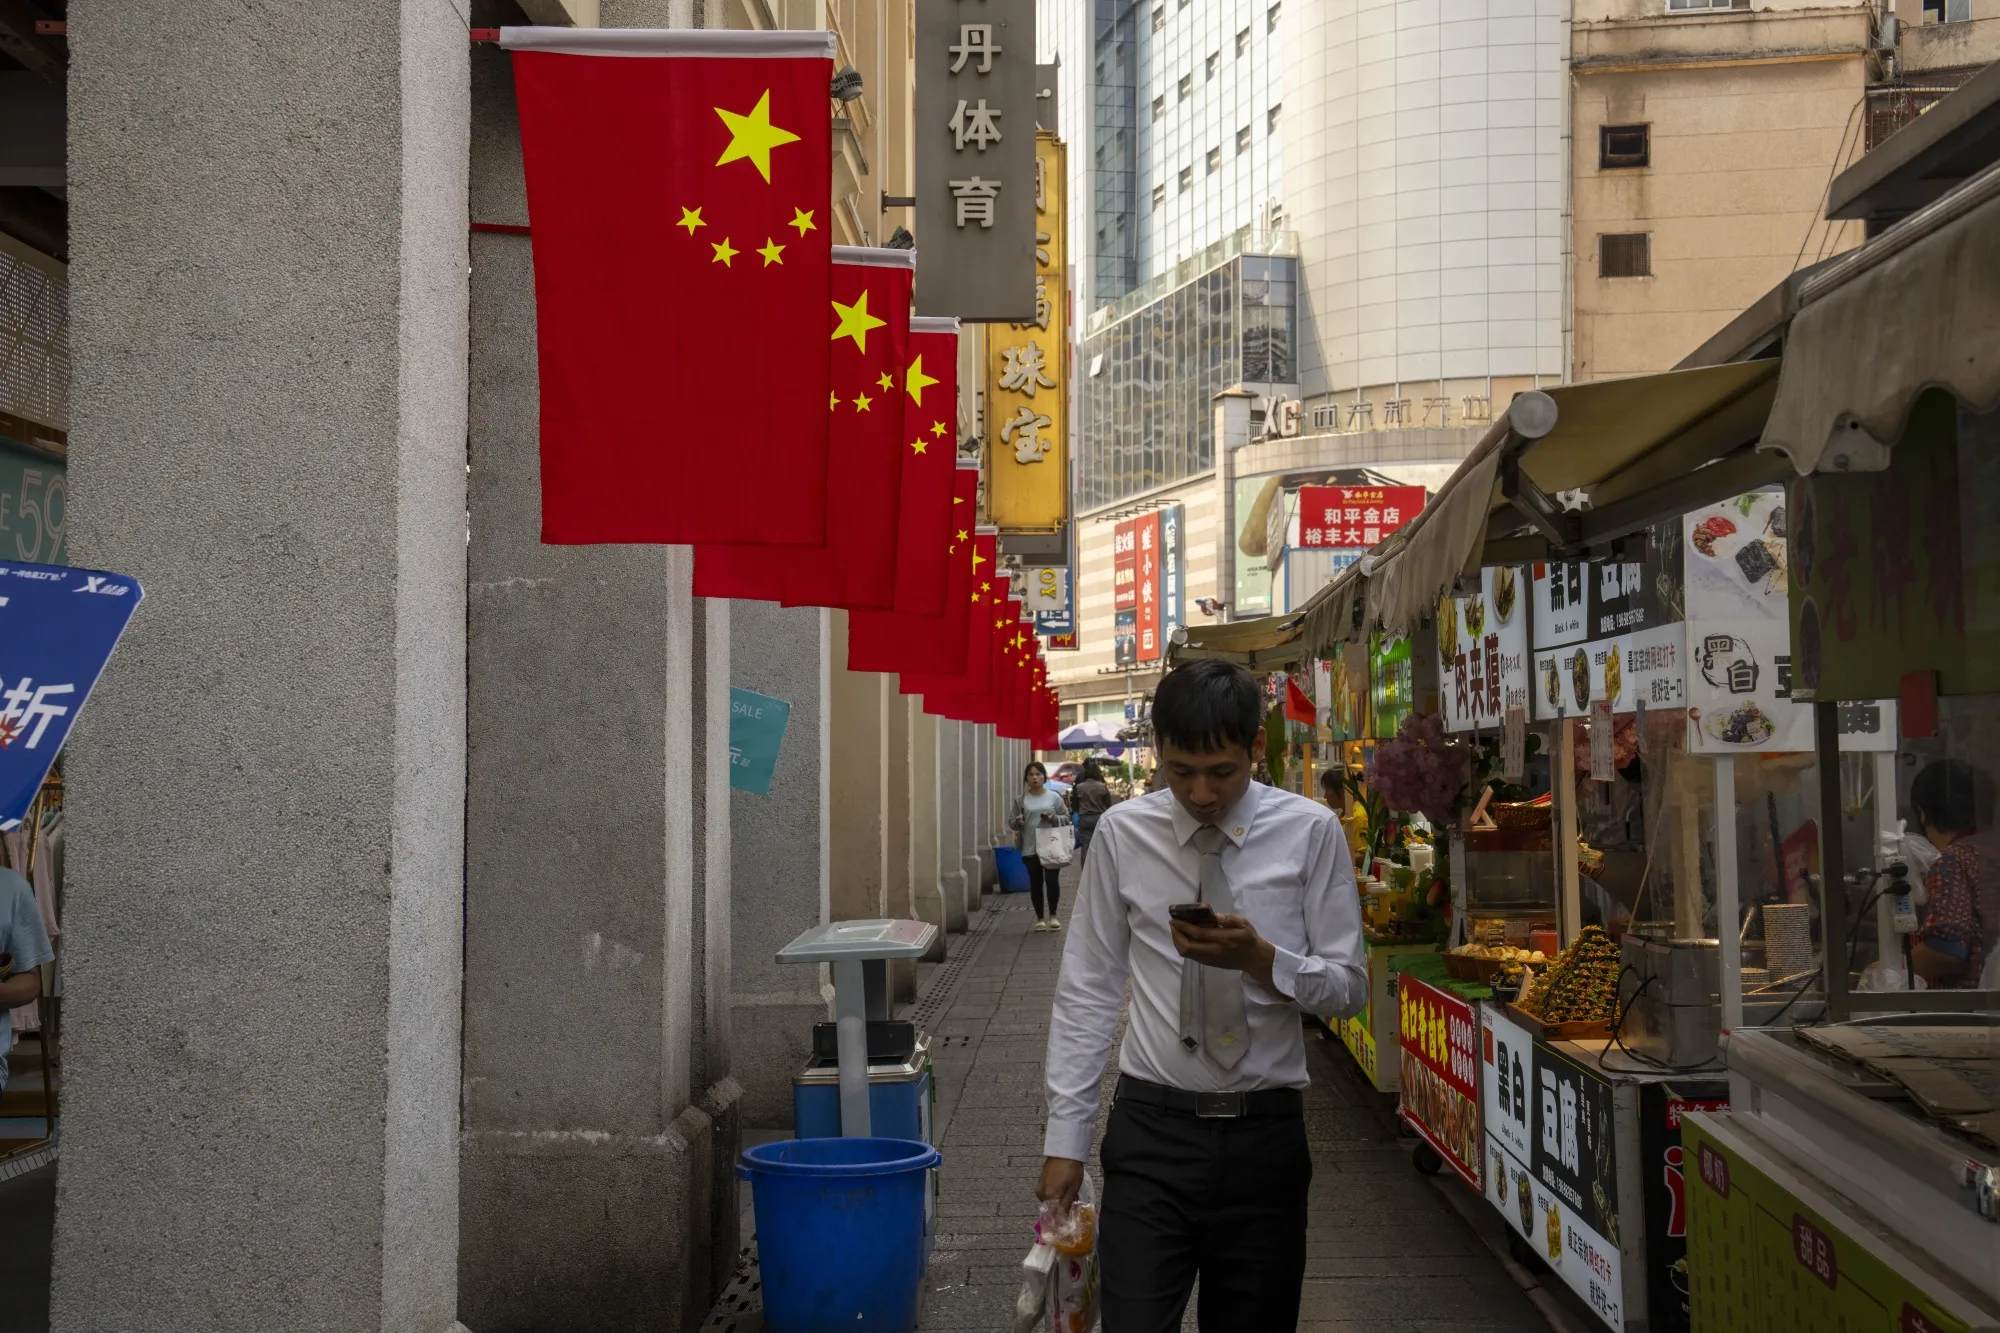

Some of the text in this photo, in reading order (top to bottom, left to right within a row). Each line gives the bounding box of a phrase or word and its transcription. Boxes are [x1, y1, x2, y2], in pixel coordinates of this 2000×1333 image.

[1324, 507, 1400, 525] 和平金店
[0, 676, 75, 749] 折
[731, 701, 763, 720] SALE
[1496, 1039, 1526, 1130] 黑白
[1541, 1065, 1580, 1177] 豆腐
[1799, 1224, 1831, 1281] 甜品
